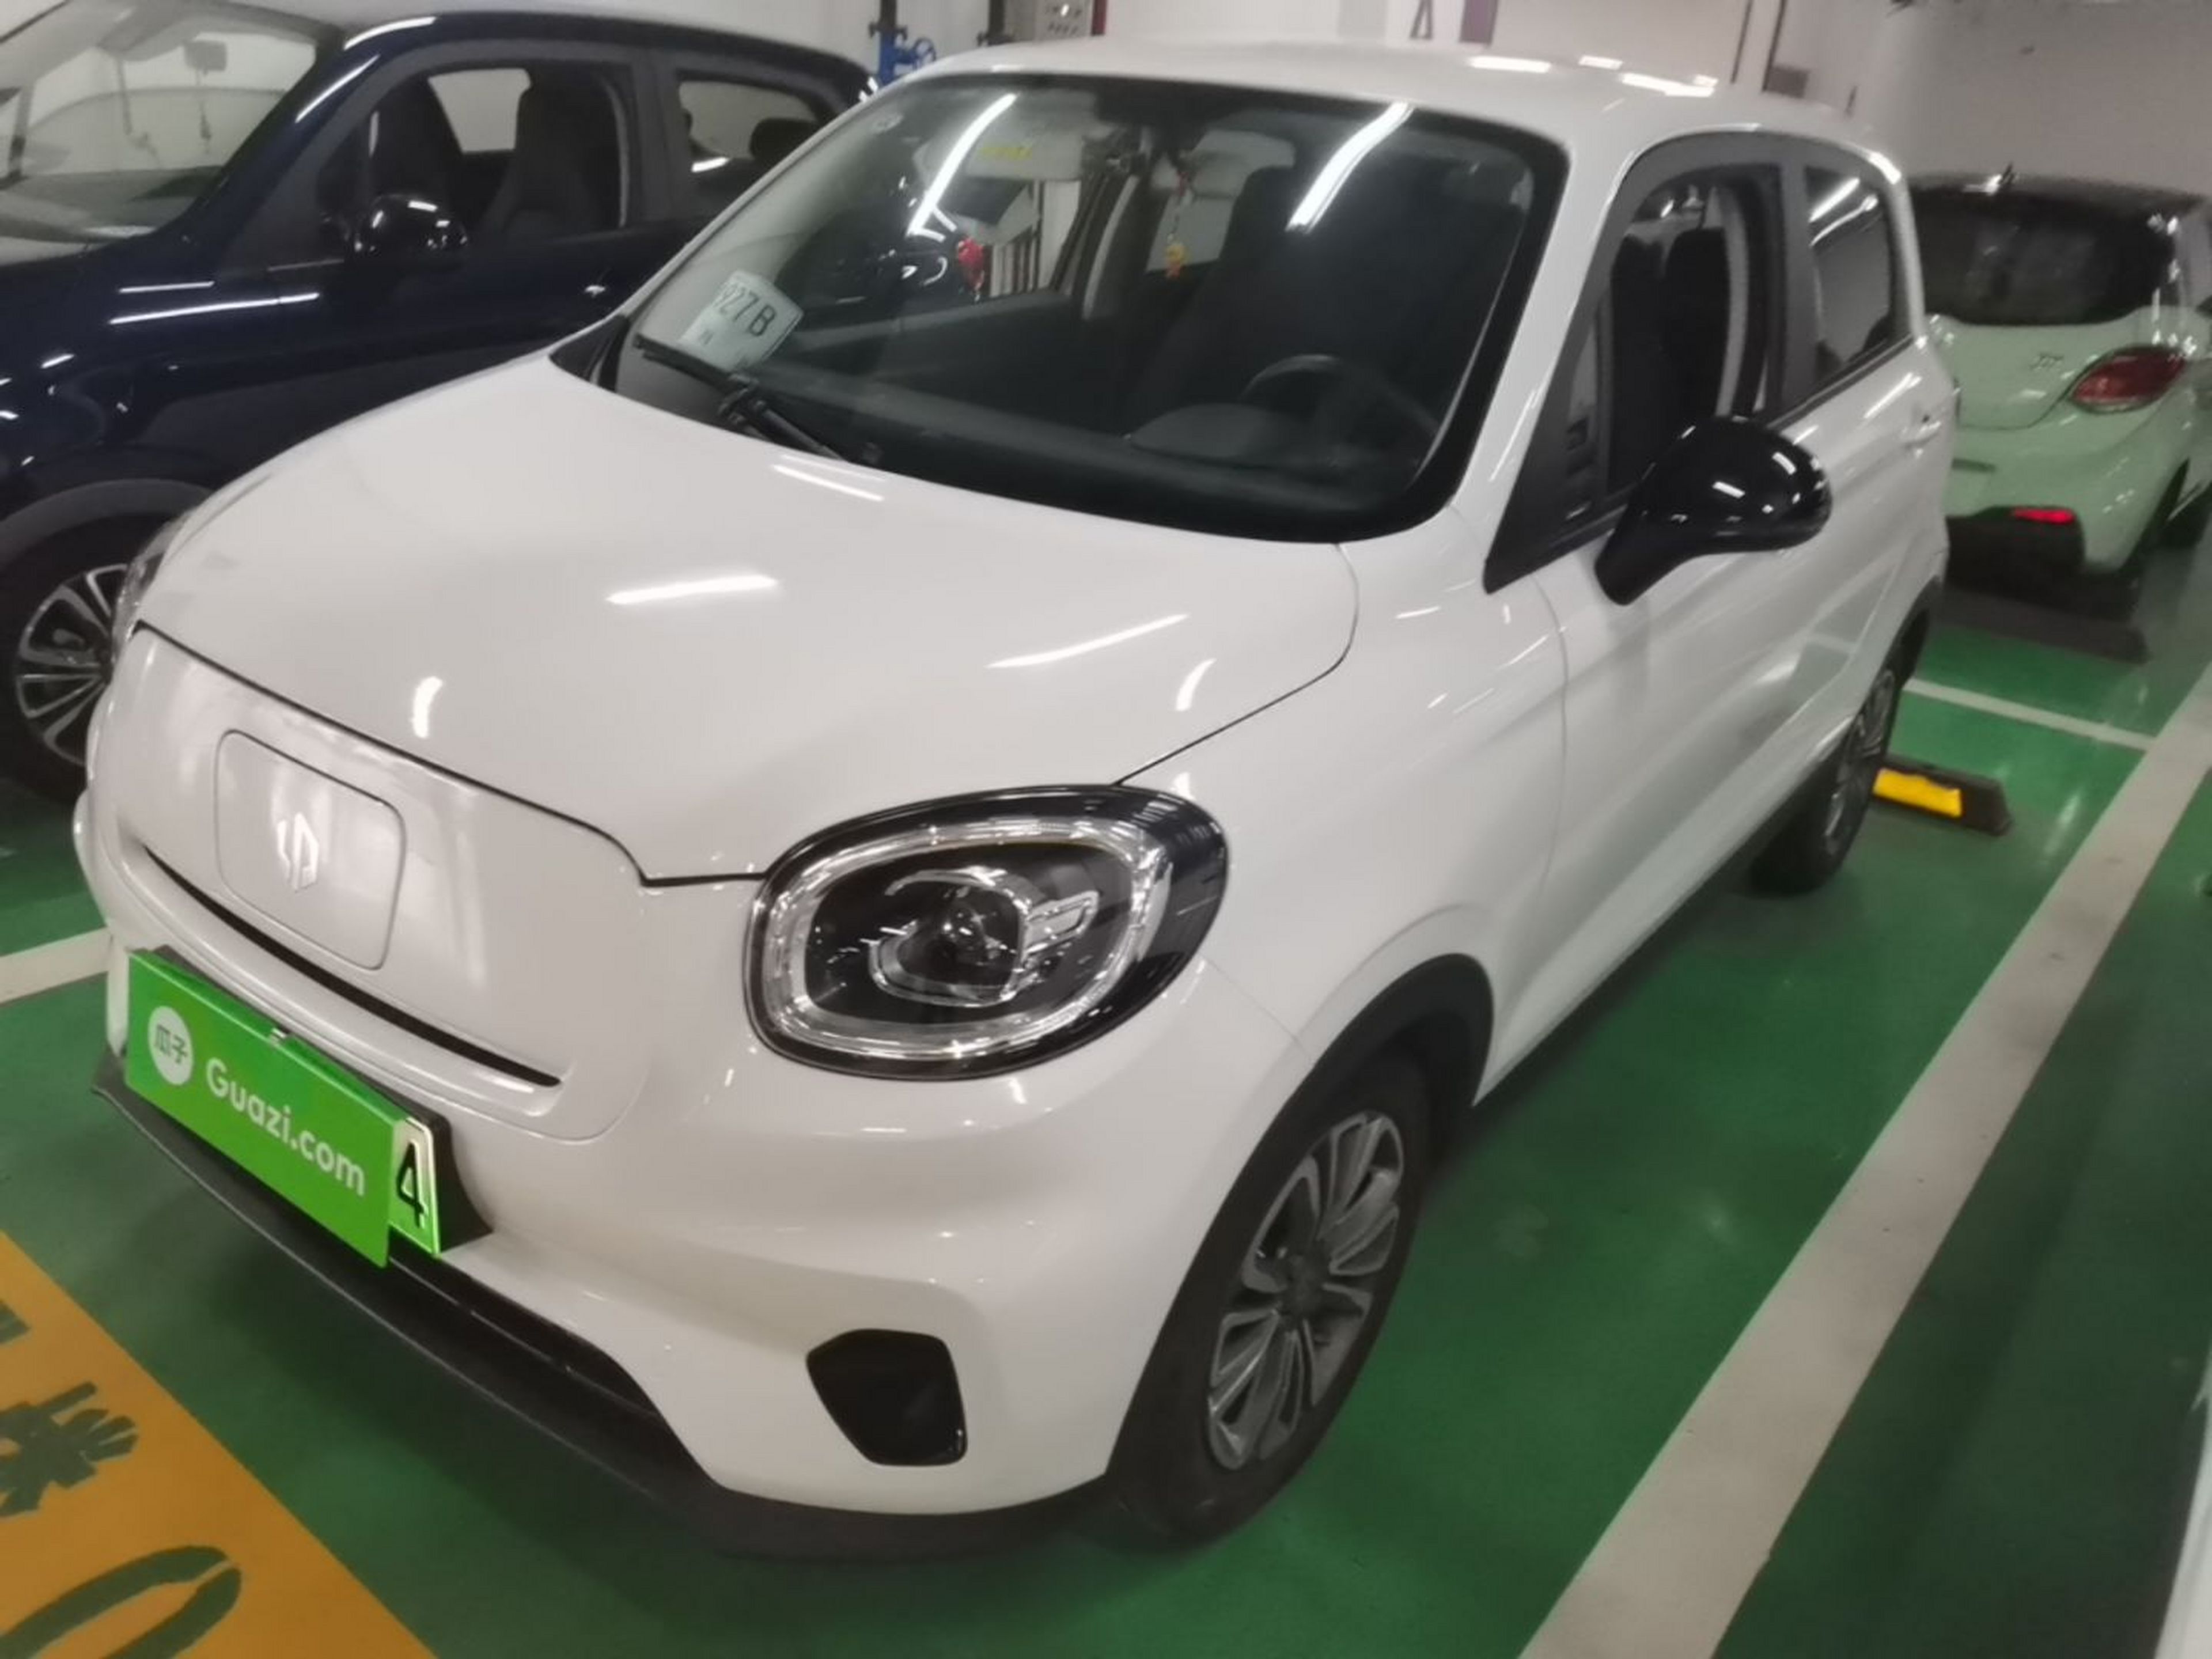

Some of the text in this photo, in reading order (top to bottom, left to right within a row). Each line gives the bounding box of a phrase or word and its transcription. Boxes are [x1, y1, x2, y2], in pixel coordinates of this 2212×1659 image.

[154, 1025, 188, 1065] 瓜子
[206, 1057, 365, 1196] Guazi.com
[397, 1142, 426, 1228] 4
